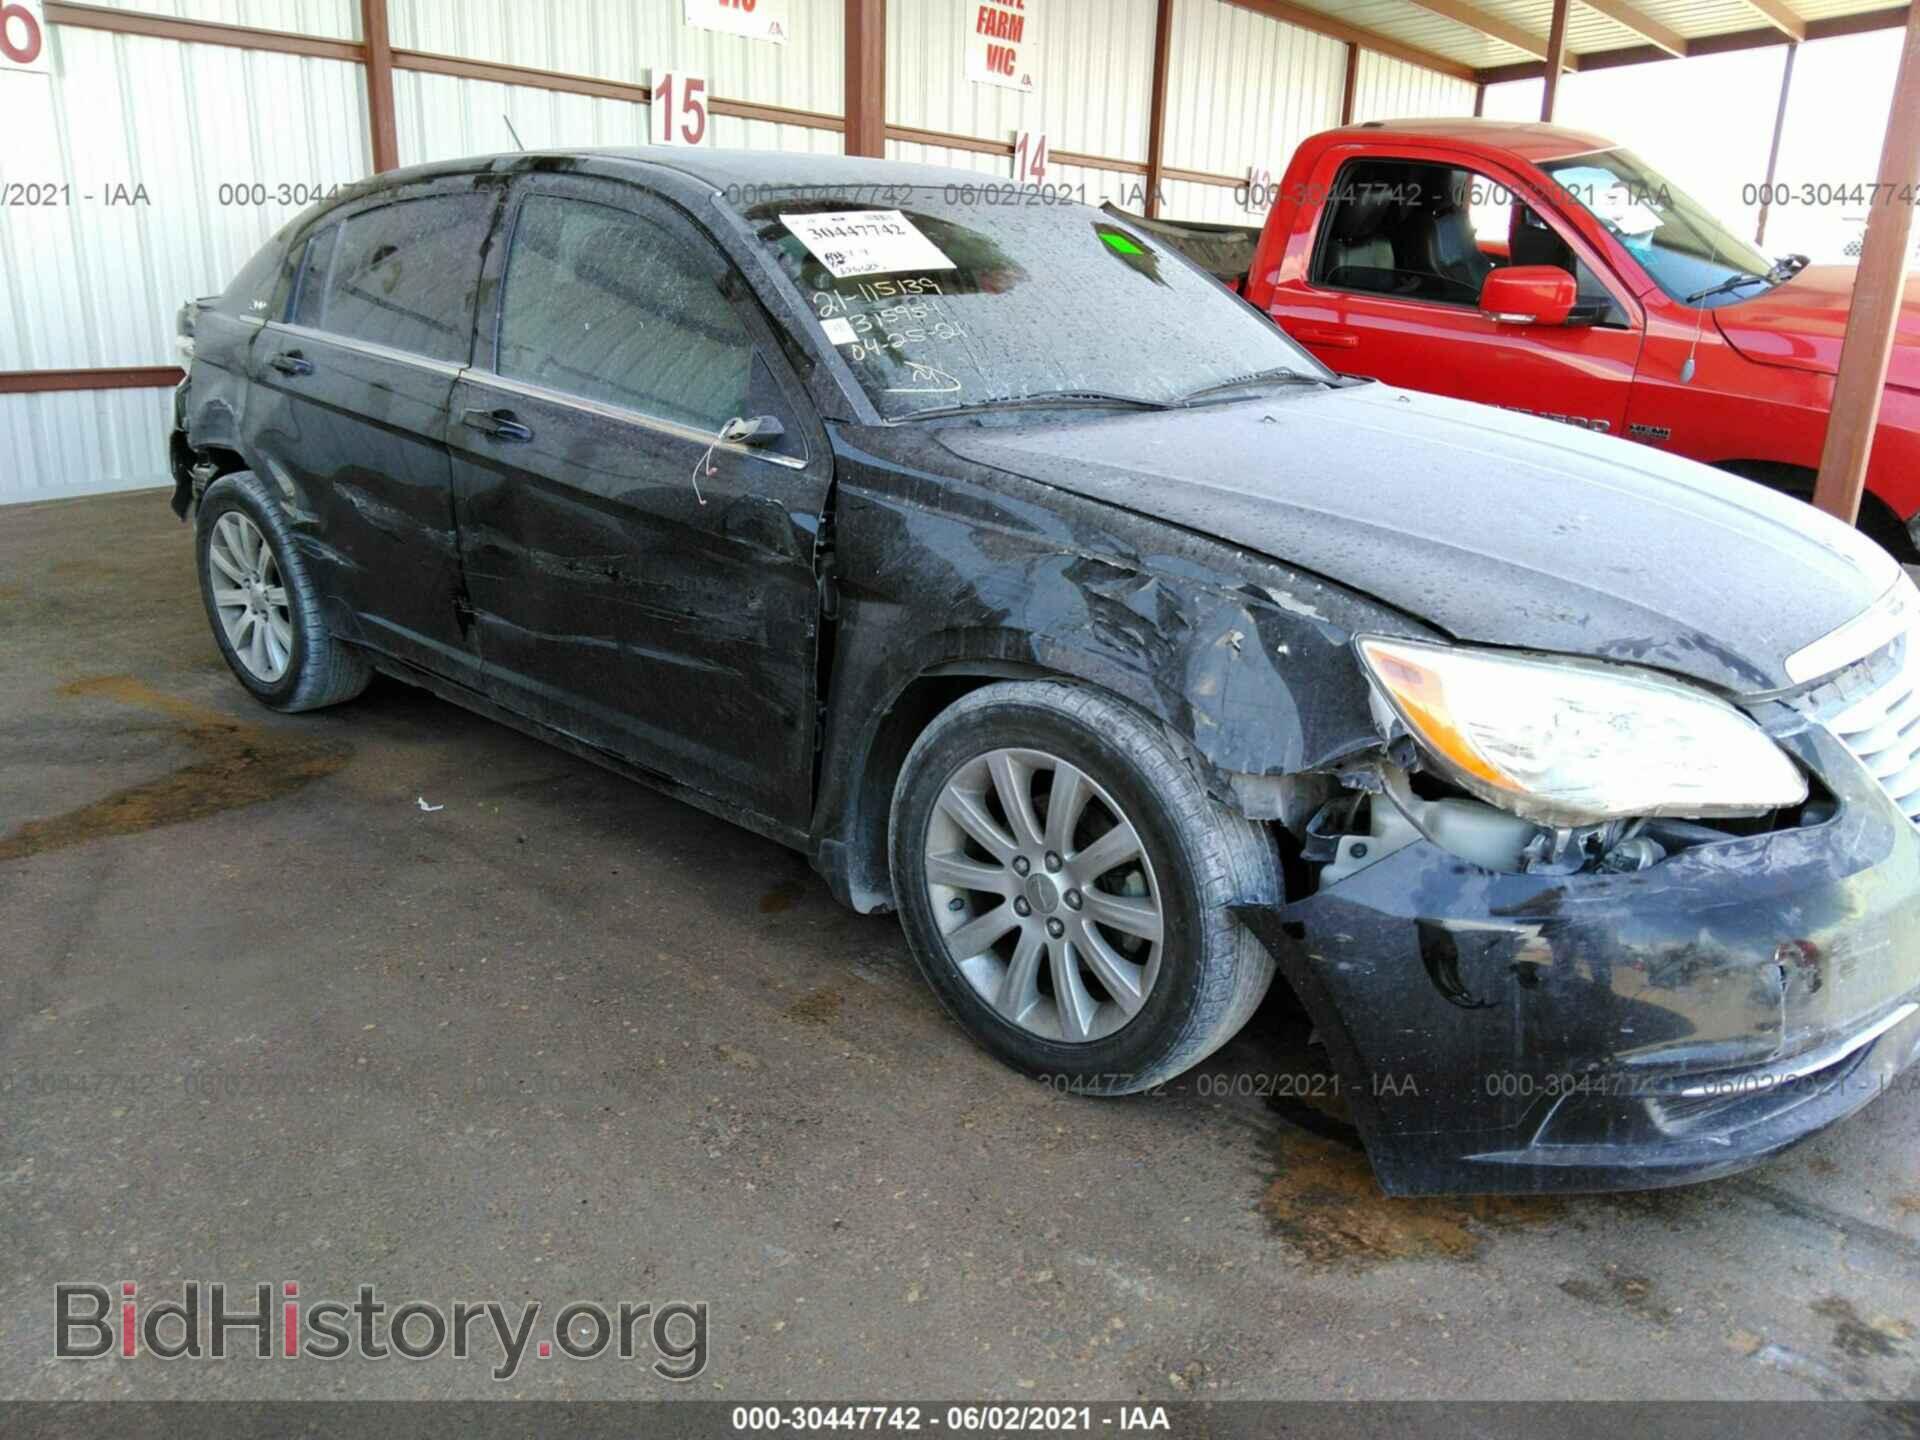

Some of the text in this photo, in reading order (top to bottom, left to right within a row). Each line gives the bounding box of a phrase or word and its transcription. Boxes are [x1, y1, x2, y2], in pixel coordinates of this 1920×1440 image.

[976, 5, 1024, 43] FARM
[986, 43, 1016, 76] VIC
[656, 73, 705, 145] 15
[1017, 132, 1046, 187] 14
